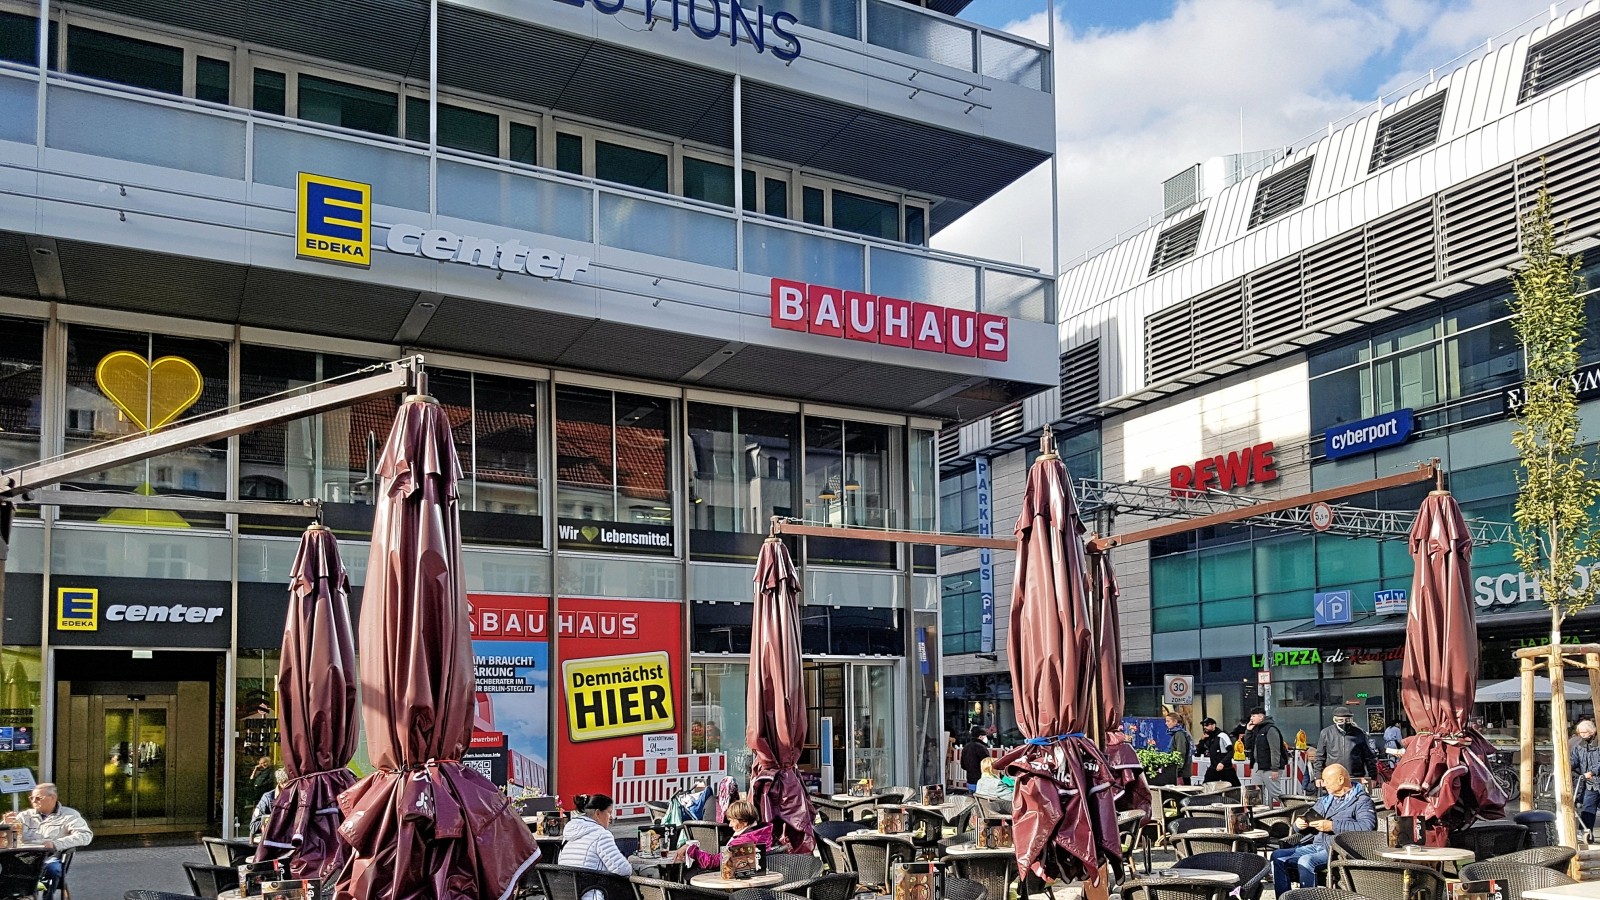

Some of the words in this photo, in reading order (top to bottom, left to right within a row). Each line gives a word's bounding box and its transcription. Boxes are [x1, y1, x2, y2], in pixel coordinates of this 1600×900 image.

[552, 0, 801, 61] IONS
[306, 238, 364, 257] EDEKA
[386, 223, 590, 281] center
[779, 286, 1006, 352] BAUHAUS
[1331, 417, 1398, 450] cyberport
[1170, 441, 1278, 499] REWE
[978, 463, 990, 581] PARKHUS
[559, 525, 579, 540] Wir
[601, 528, 673, 547] Lebensmittel.
[1474, 561, 1600, 607] SCHO
[105, 604, 223, 623] center
[1331, 603, 1343, 619] P
[483, 612, 638, 635] BAUHAUS
[1541, 635, 1581, 645] PZA
[488, 656, 534, 666] BRAUCHT
[1275, 649, 1322, 666] PIZZA
[572, 664, 663, 688] Demnächst
[1173, 682, 1184, 692] 30
[574, 684, 669, 729] HIER
